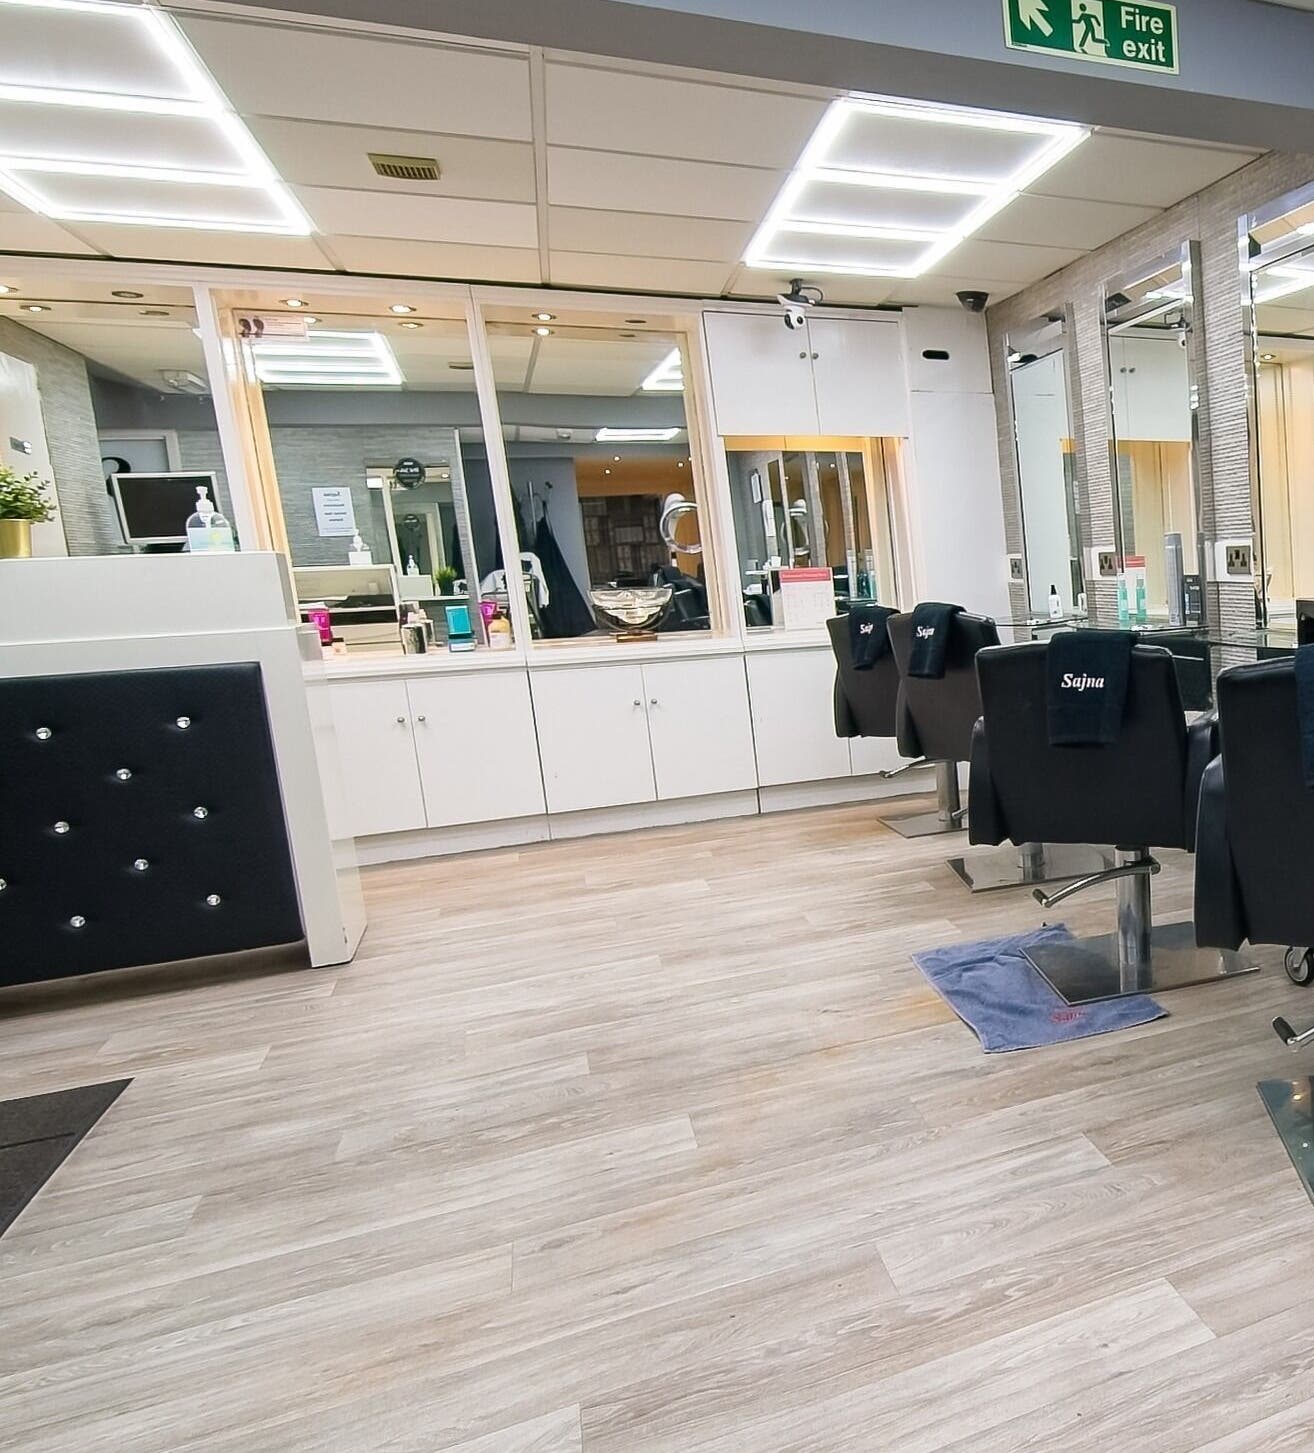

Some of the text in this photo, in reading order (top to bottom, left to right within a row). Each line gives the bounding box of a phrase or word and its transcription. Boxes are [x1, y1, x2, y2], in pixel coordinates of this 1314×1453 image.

[1120, 5, 1164, 35] Fire
[1122, 38, 1166, 63] exit
[1060, 672, 1105, 692] Sajna
